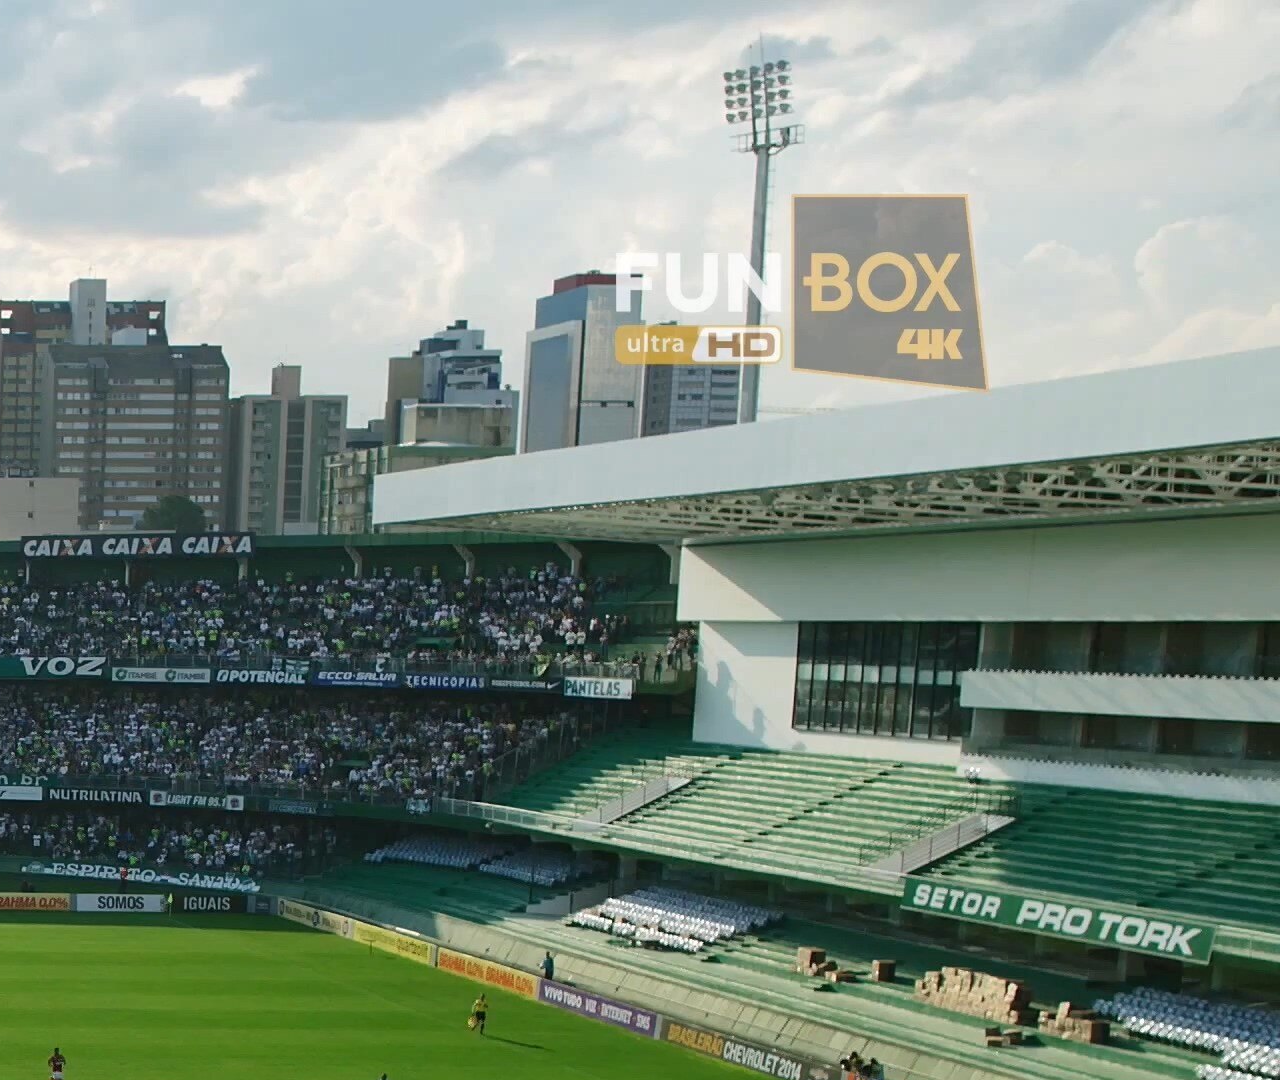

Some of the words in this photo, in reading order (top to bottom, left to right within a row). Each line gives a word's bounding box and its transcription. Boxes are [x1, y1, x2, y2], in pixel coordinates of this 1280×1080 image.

[24, 539, 93, 557] CAIXA
[102, 538, 173, 555] CAIXA
[182, 536, 252, 554] CAIXA
[20, 656, 107, 676] VOZ
[229, 670, 306, 684] POTENCIAL
[565, 679, 621, 697] PANTELAS
[50, 788, 143, 803] NUTRILATINA
[167, 794, 192, 805] LIGHT
[192, 796, 207, 806] FM
[52, 863, 156, 883] ESPIRTO
[97, 896, 145, 909] SOMOS
[184, 897, 231, 910] IGUAIS
[913, 884, 1001, 919] SETOR
[1016, 900, 1093, 936] PRO
[1097, 912, 1203, 955] TORK
[723, 1041, 779, 1075] CHEVROLET
